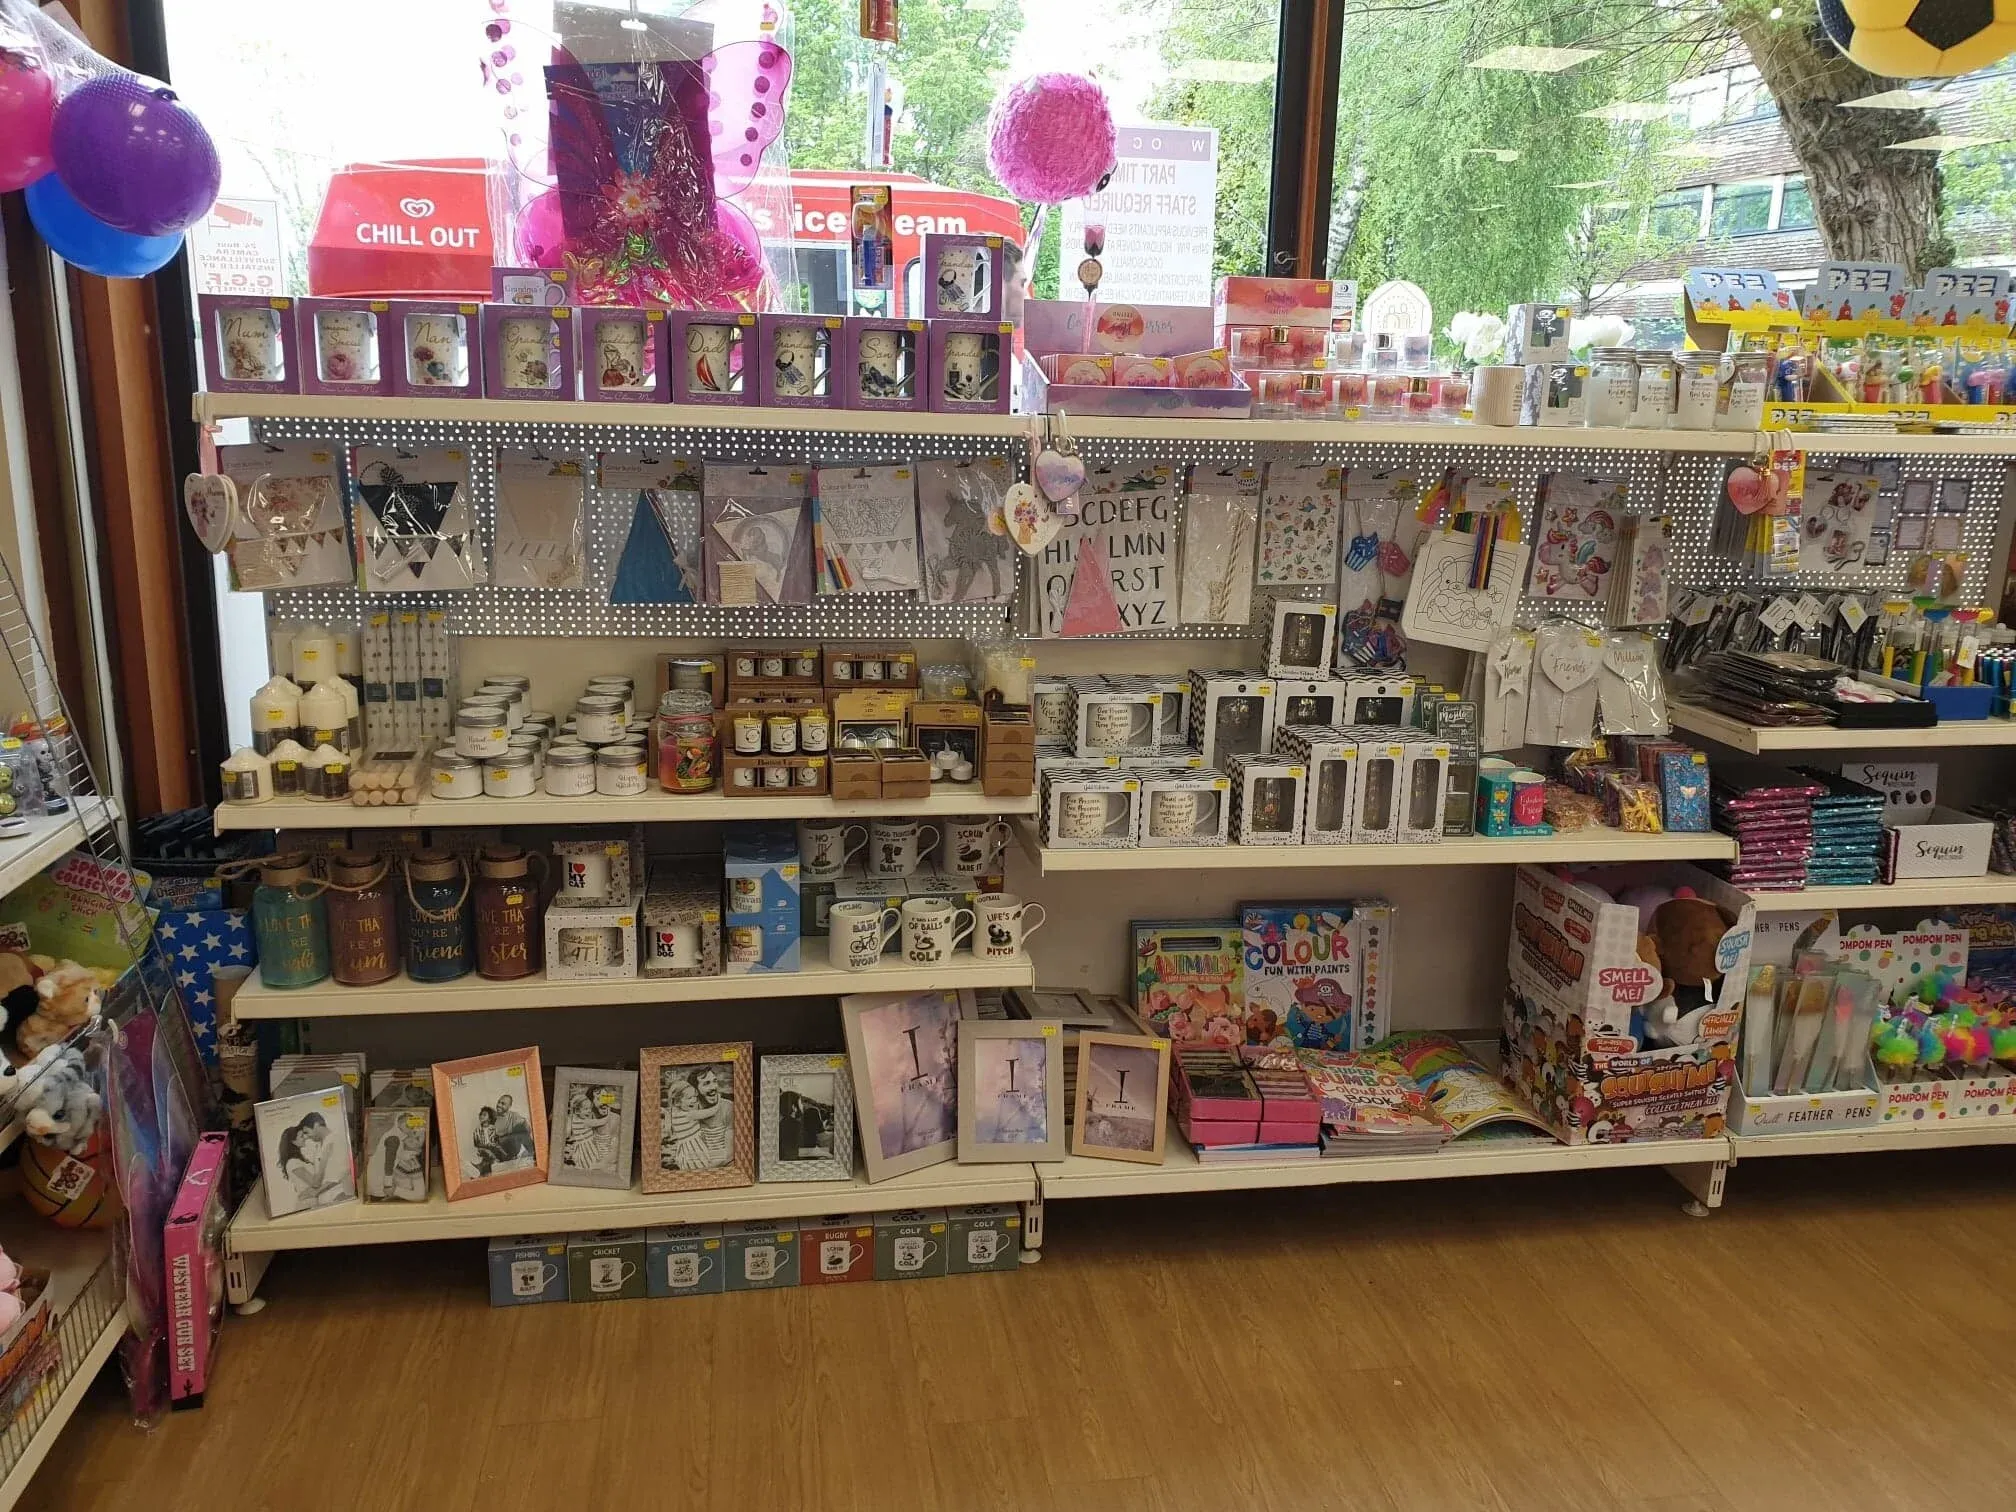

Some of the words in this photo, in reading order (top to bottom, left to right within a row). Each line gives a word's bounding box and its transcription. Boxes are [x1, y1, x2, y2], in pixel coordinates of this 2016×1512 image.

[795, 204, 847, 233] ice
[893, 214, 966, 236] eam
[356, 222, 424, 246] CHILL
[430, 226, 480, 249] OUT
[1700, 272, 1767, 291] PEZ
[1827, 268, 1894, 291] PEZ
[1928, 275, 1999, 297] PEZ
[688, 329, 726, 354] Dad
[860, 338, 894, 359] Son
[1863, 764, 1918, 785] Sequin
[1916, 840, 1967, 859] Sequin
[568, 873, 587, 882] MY
[568, 880, 586, 889] CAT
[1780, 922, 1800, 932] PENS
[1874, 940, 1893, 949] PEN
[1903, 935, 1943, 945] POMPOM
[1944, 934, 1962, 944] PEN
[657, 942, 675, 952] MY
[986, 946, 1014, 956] PITCH
[1245, 931, 1350, 971] COLOUR
[909, 950, 943, 962] GOLF
[1264, 966, 1283, 976] FUN
[1286, 965, 1312, 976] WITH
[1314, 964, 1350, 975] PAINTS
[1600, 970, 1651, 984] SMELL
[1615, 986, 1642, 1000] ME!
[1594, 1062, 1609, 1070] THE
[1314, 1073, 1395, 1088] JUMBO
[1346, 1094, 1394, 1106] BOOK
[1889, 1093, 1930, 1104] POMPOM
[1932, 1091, 1949, 1101] PEN
[1964, 1088, 2005, 1099] POMPOM
[1646, 1102, 1678, 1115] COLLECT
[1788, 1109, 1834, 1123] FEATHER
[1846, 1106, 1872, 1119] PENS
[974, 1220, 995, 1228] GOLF
[824, 1232, 849, 1241] RUGBY
[592, 1248, 621, 1256] CRICKET
[173, 1254, 192, 1318] WESTERN
[176, 1320, 194, 1346] GUN
[177, 1346, 195, 1372] SET
